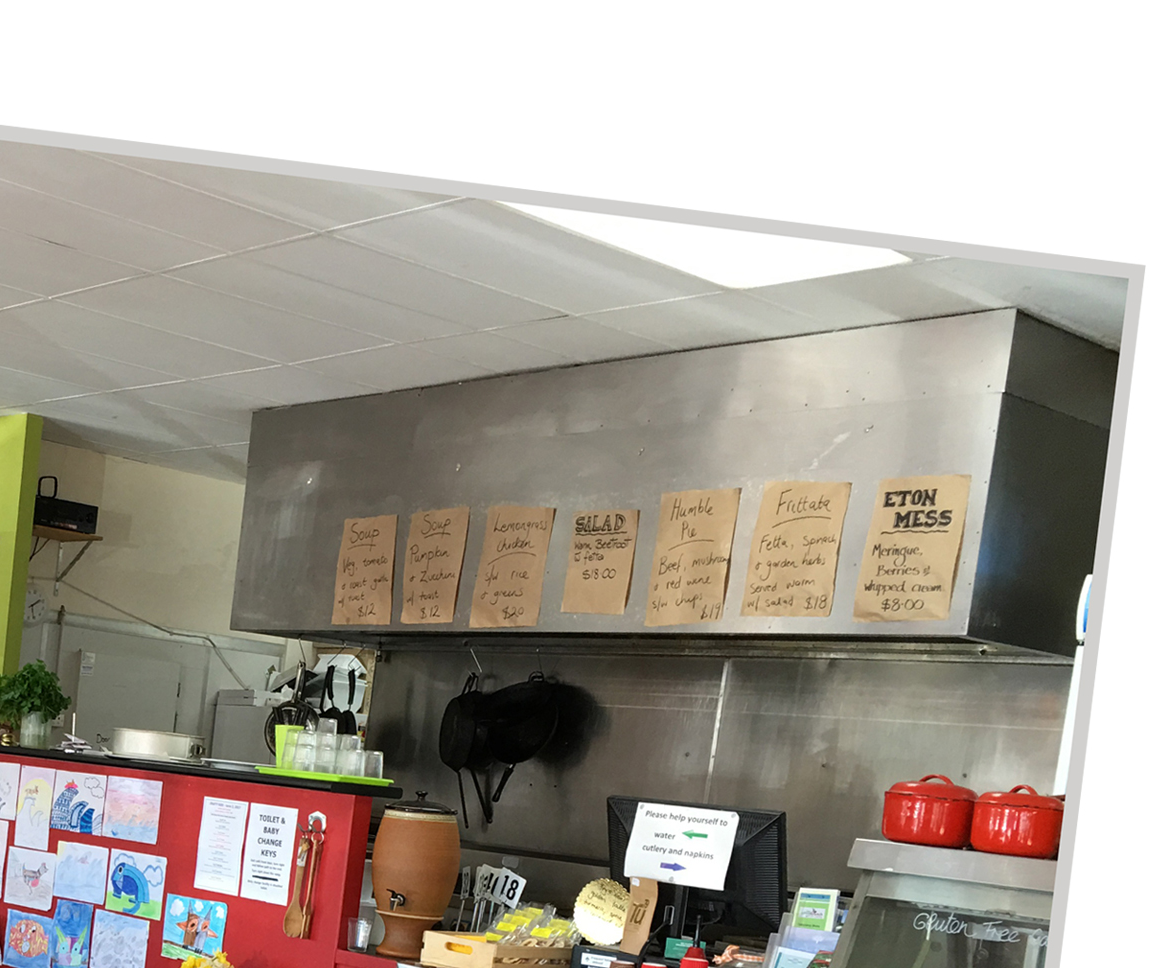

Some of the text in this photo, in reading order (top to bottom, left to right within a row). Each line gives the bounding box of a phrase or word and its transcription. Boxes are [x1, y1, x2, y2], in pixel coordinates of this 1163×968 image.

[776, 489, 831, 515] Frittata
[883, 489, 937, 508] ETON
[671, 497, 713, 521] Humble
[421, 514, 451, 538] Soup
[493, 513, 547, 540] Lemongrass
[893, 510, 952, 528] MESS
[350, 523, 380, 552] Soup
[681, 521, 697, 540] Pie
[410, 544, 450, 570] Pumpkin
[511, 570, 529, 580] rice
[760, 559, 798, 581] garden
[876, 564, 920, 576] Berries
[666, 576, 681, 589] red
[687, 576, 711, 586] wine
[358, 603, 375, 617] $12
[765, 596, 793, 607] salad
[804, 594, 828, 610] $18
[503, 606, 524, 619] $20
[701, 603, 721, 620] $19
[260, 814, 280, 824] TOILET
[645, 810, 668, 819] Please
[669, 812, 686, 822] help
[688, 817, 719, 826] yourself
[263, 827, 279, 835] BABY
[654, 832, 675, 840] water
[258, 838, 282, 847] CHANGE
[261, 850, 277, 858] KEYS
[642, 845, 667, 854] cutlery
[685, 850, 714, 860] napkins
[500, 875, 519, 900] 18
[913, 911, 977, 938] Gluten
[983, 921, 1020, 942] Free
